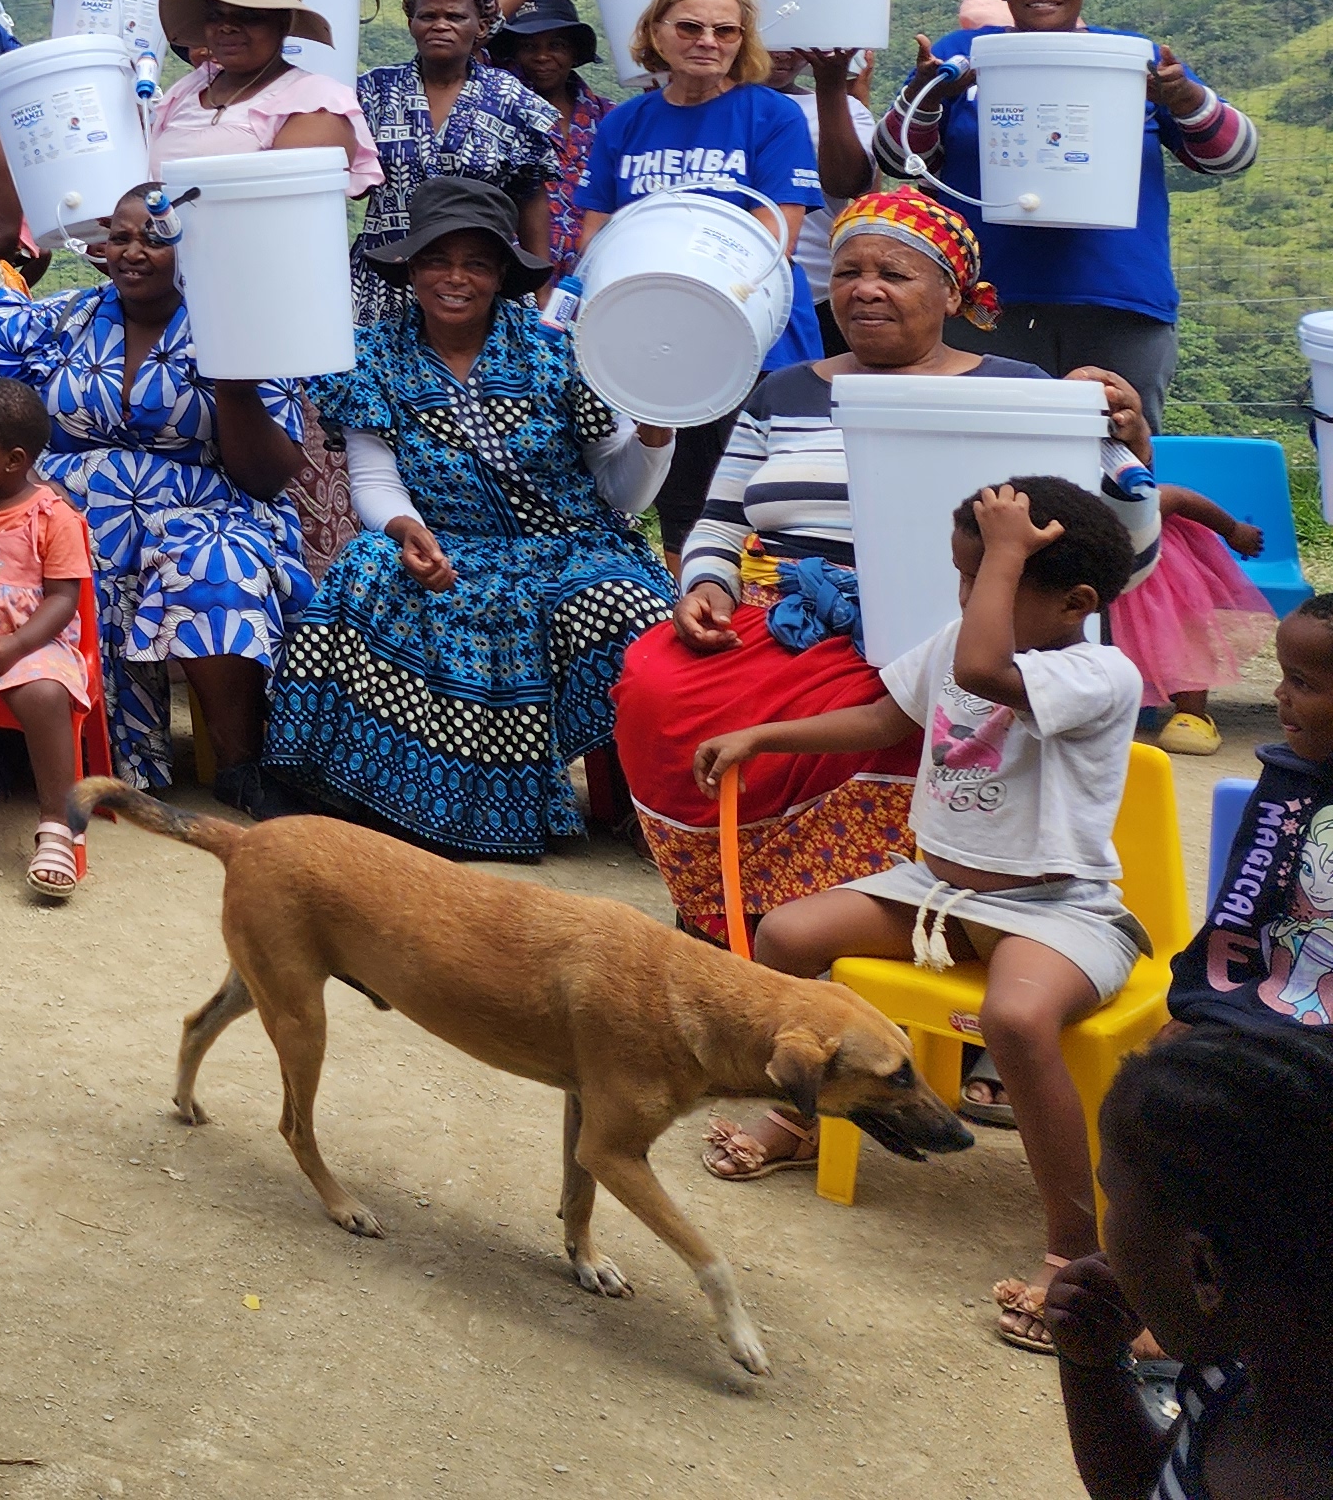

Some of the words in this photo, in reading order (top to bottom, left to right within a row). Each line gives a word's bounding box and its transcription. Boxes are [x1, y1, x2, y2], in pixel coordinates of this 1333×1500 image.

[81, 2, 113, 10] AMANZI
[13, 110, 44, 126] AMANZI
[620, 148, 747, 179] ITHEMBA
[948, 780, 1007, 813] 59
[1213, 801, 1287, 931] MAGICAL
